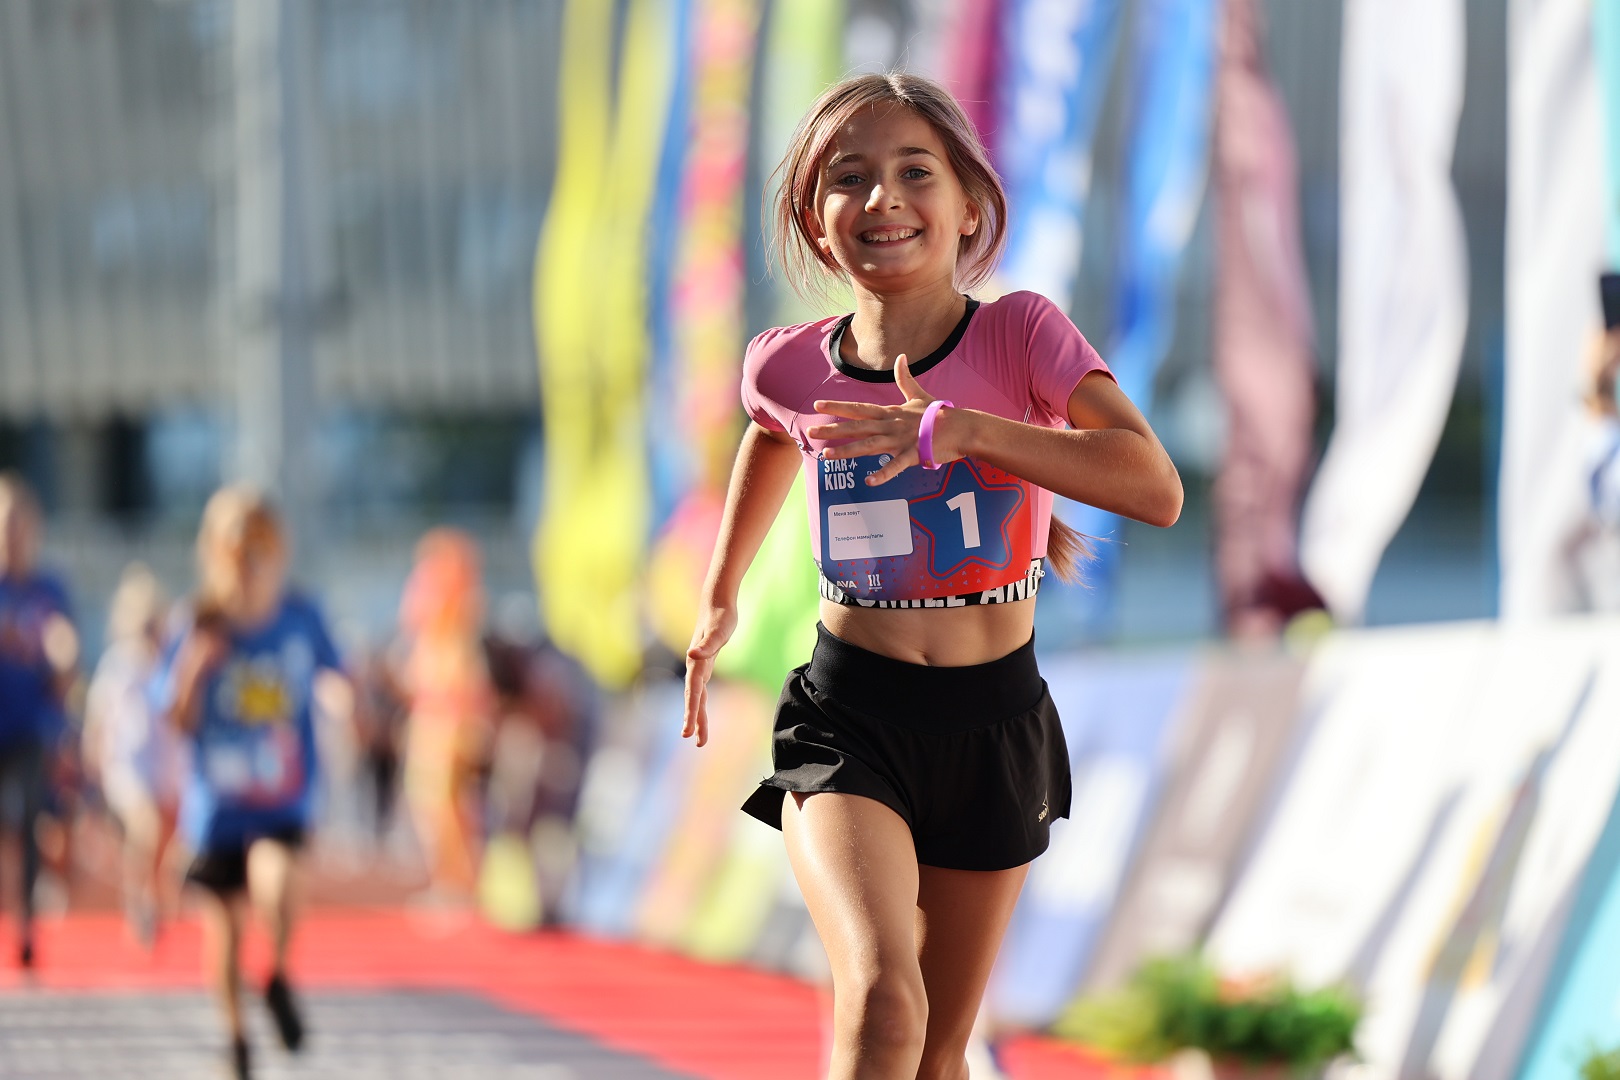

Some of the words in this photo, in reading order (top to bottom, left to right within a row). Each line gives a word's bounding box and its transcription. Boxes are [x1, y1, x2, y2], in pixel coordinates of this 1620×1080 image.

[824, 459, 848, 473] STAR
[824, 472, 855, 491] KIDS
[945, 491, 981, 549] 1
